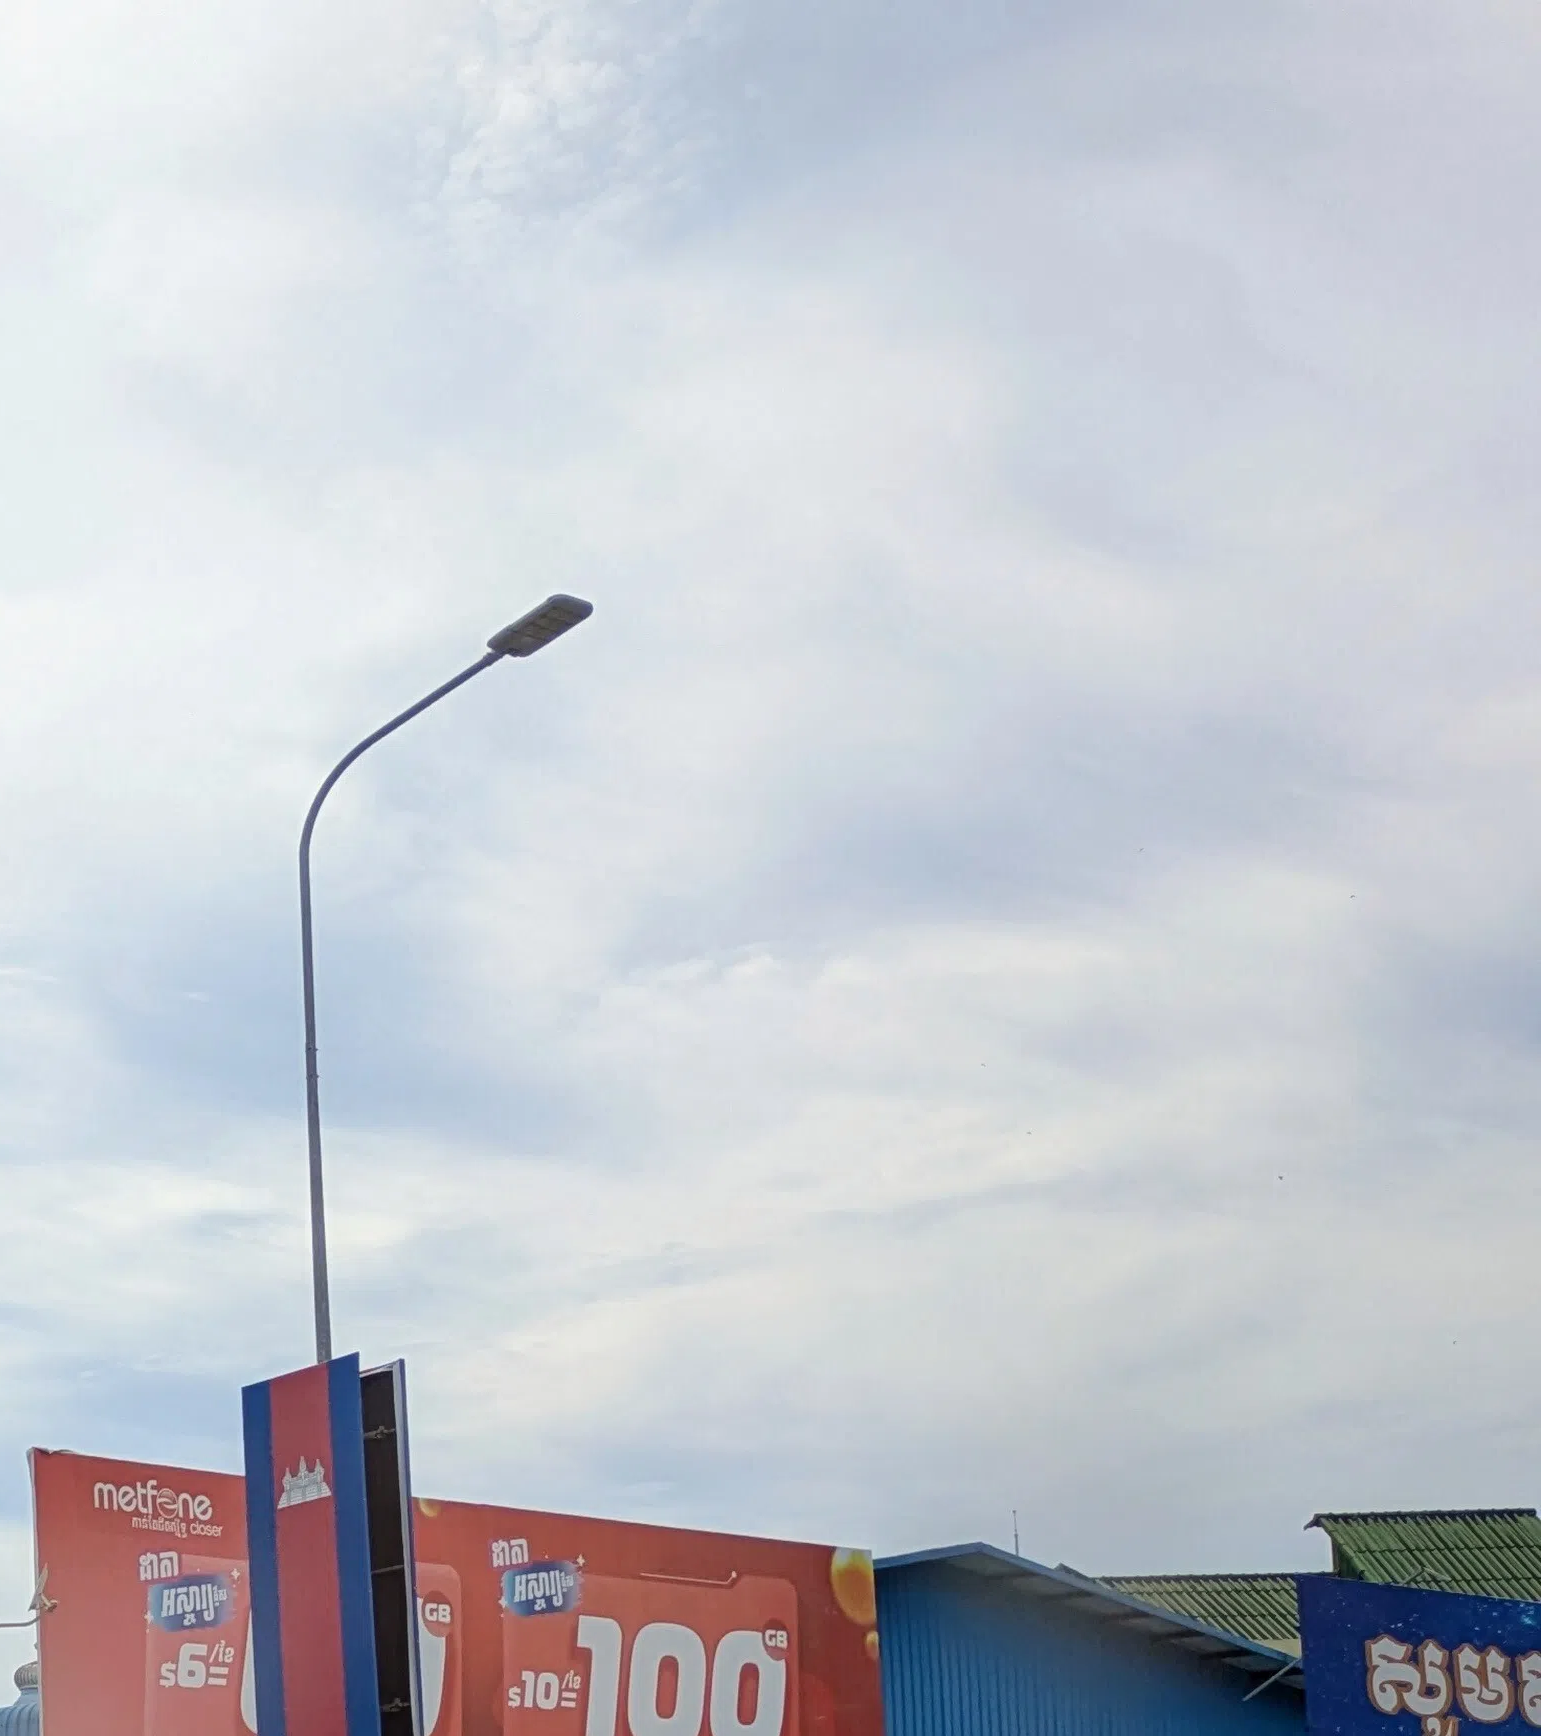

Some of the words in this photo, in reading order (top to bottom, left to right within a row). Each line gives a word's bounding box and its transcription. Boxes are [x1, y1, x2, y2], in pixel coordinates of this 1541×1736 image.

[94, 1480, 212, 1520] metfone
[190, 1521, 224, 1537] closer
[424, 1603, 451, 1623] GB
[764, 1630, 788, 1649] GB
